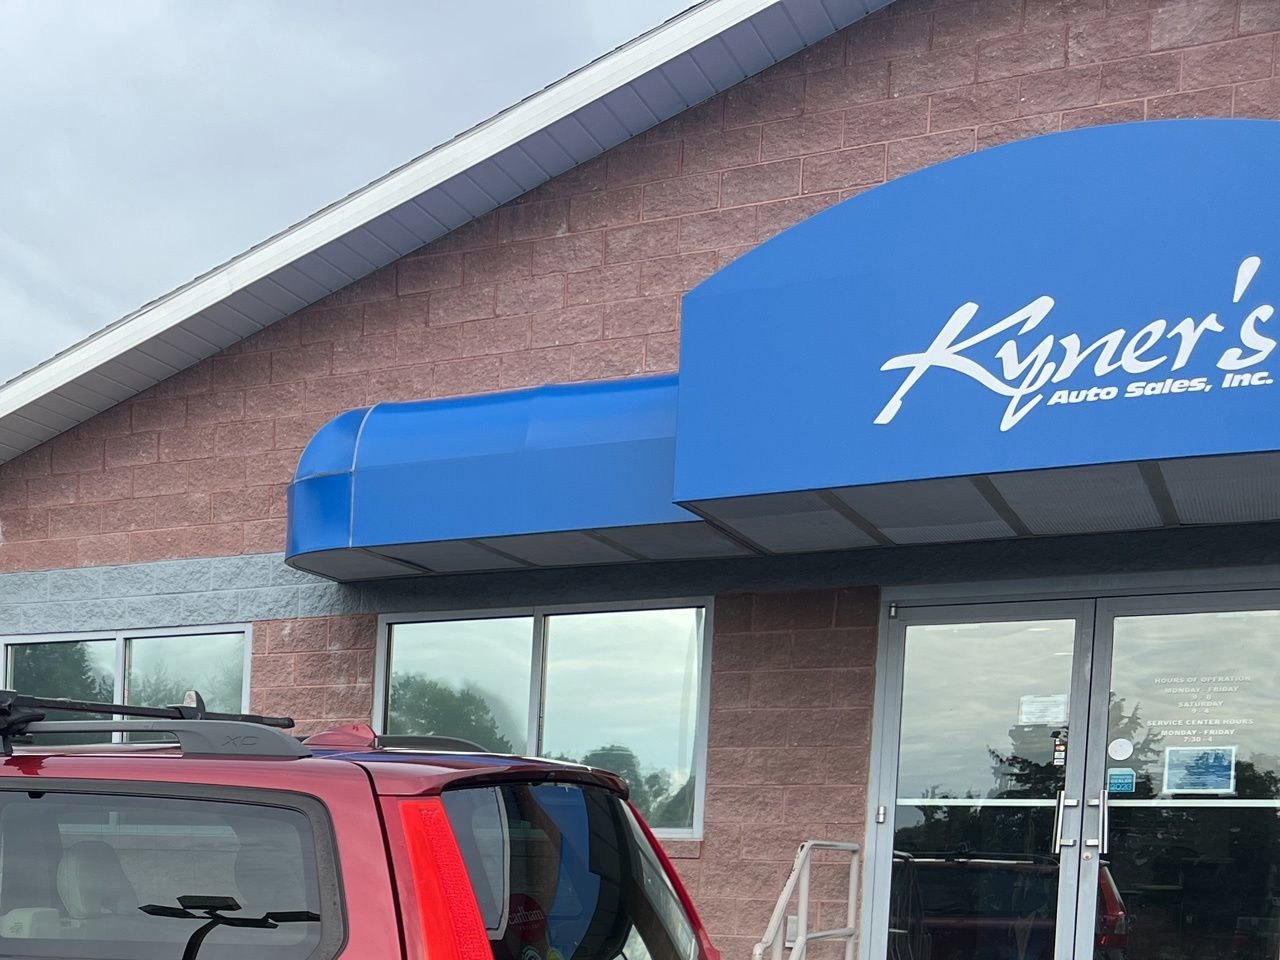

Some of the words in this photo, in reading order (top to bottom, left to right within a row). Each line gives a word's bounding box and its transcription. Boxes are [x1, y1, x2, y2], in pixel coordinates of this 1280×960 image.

[873, 255, 1277, 432] Kyner's
[1046, 385, 1118, 406] Auto
[1124, 376, 1212, 399] Sales,
[1221, 370, 1274, 390] Inc.
[1154, 676, 1185, 684] HOURS
[1200, 674, 1251, 683] OPERATION
[1207, 685, 1239, 693] FRIDAY
[1177, 700, 1224, 708] SATURDAY
[1146, 719, 1184, 727] SERVICE
[221, 735, 259, 747] XC
